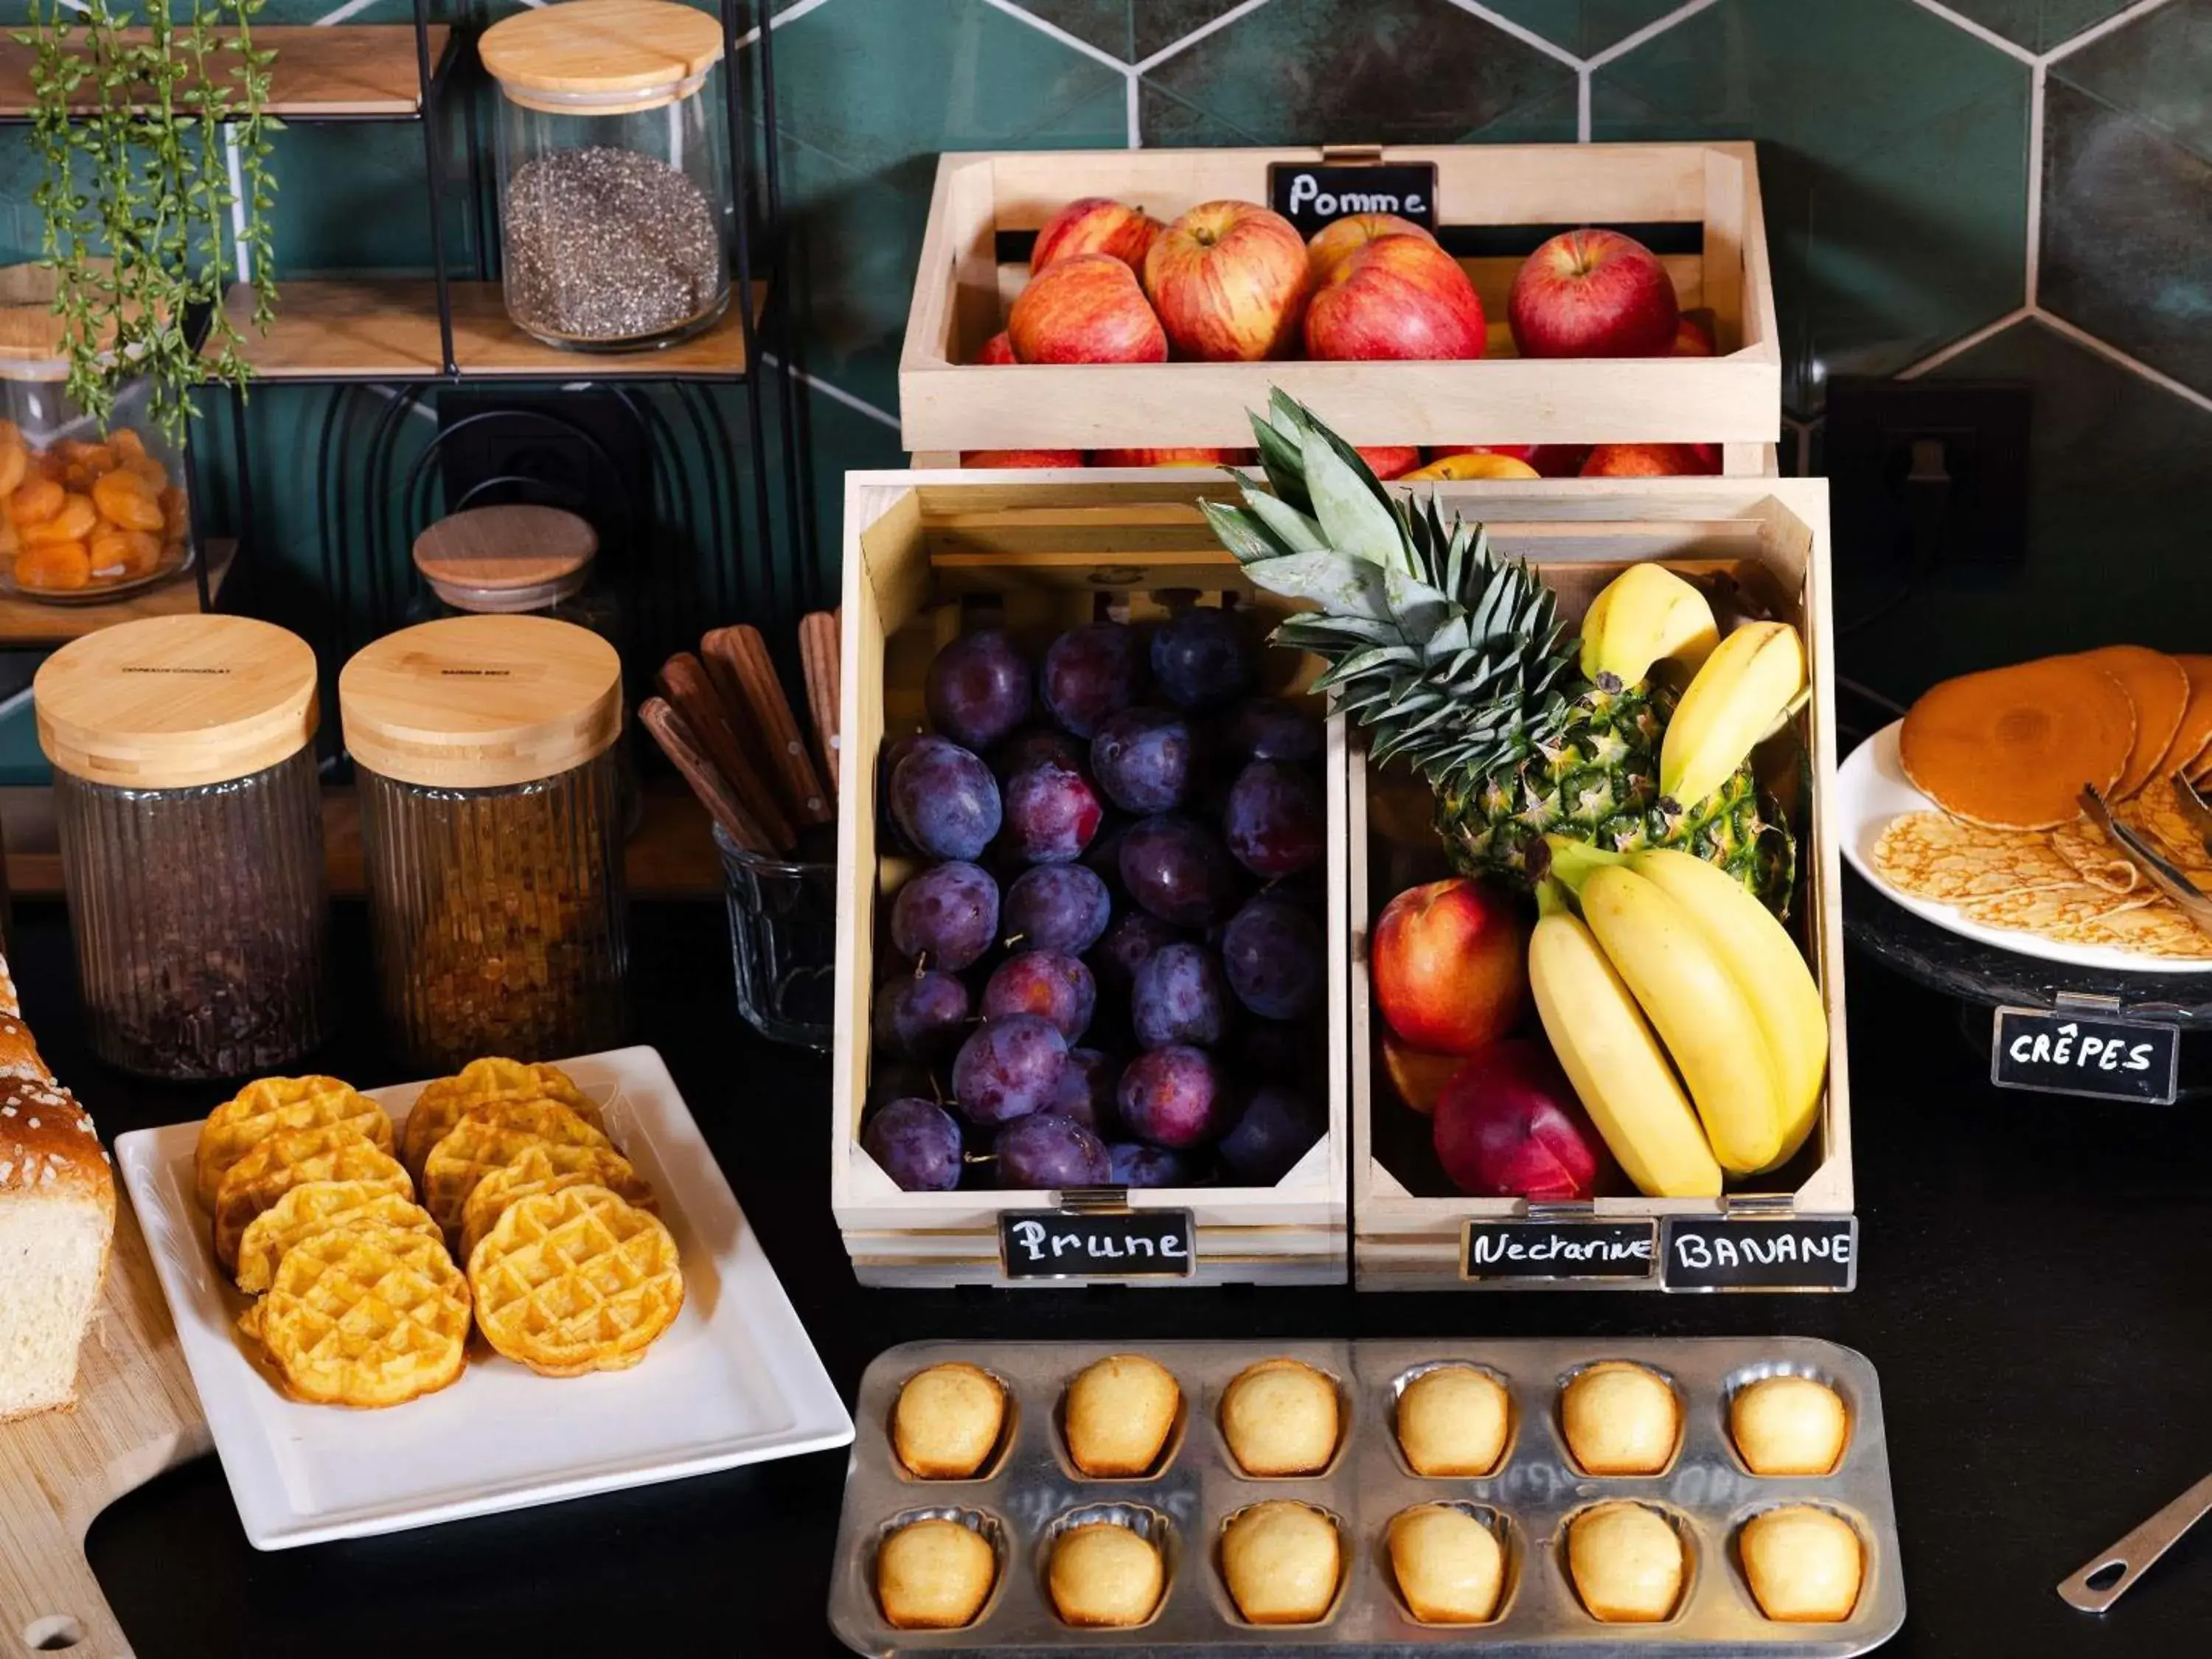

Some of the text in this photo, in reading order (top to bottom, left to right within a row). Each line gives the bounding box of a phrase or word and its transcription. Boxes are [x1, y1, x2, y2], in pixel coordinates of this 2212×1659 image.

[1290, 173, 1427, 215] Pomme
[2009, 1023, 2154, 1070] CRÊPES
[1012, 1220, 1188, 1260] Prune
[1674, 1234, 1851, 1268] BANANE
